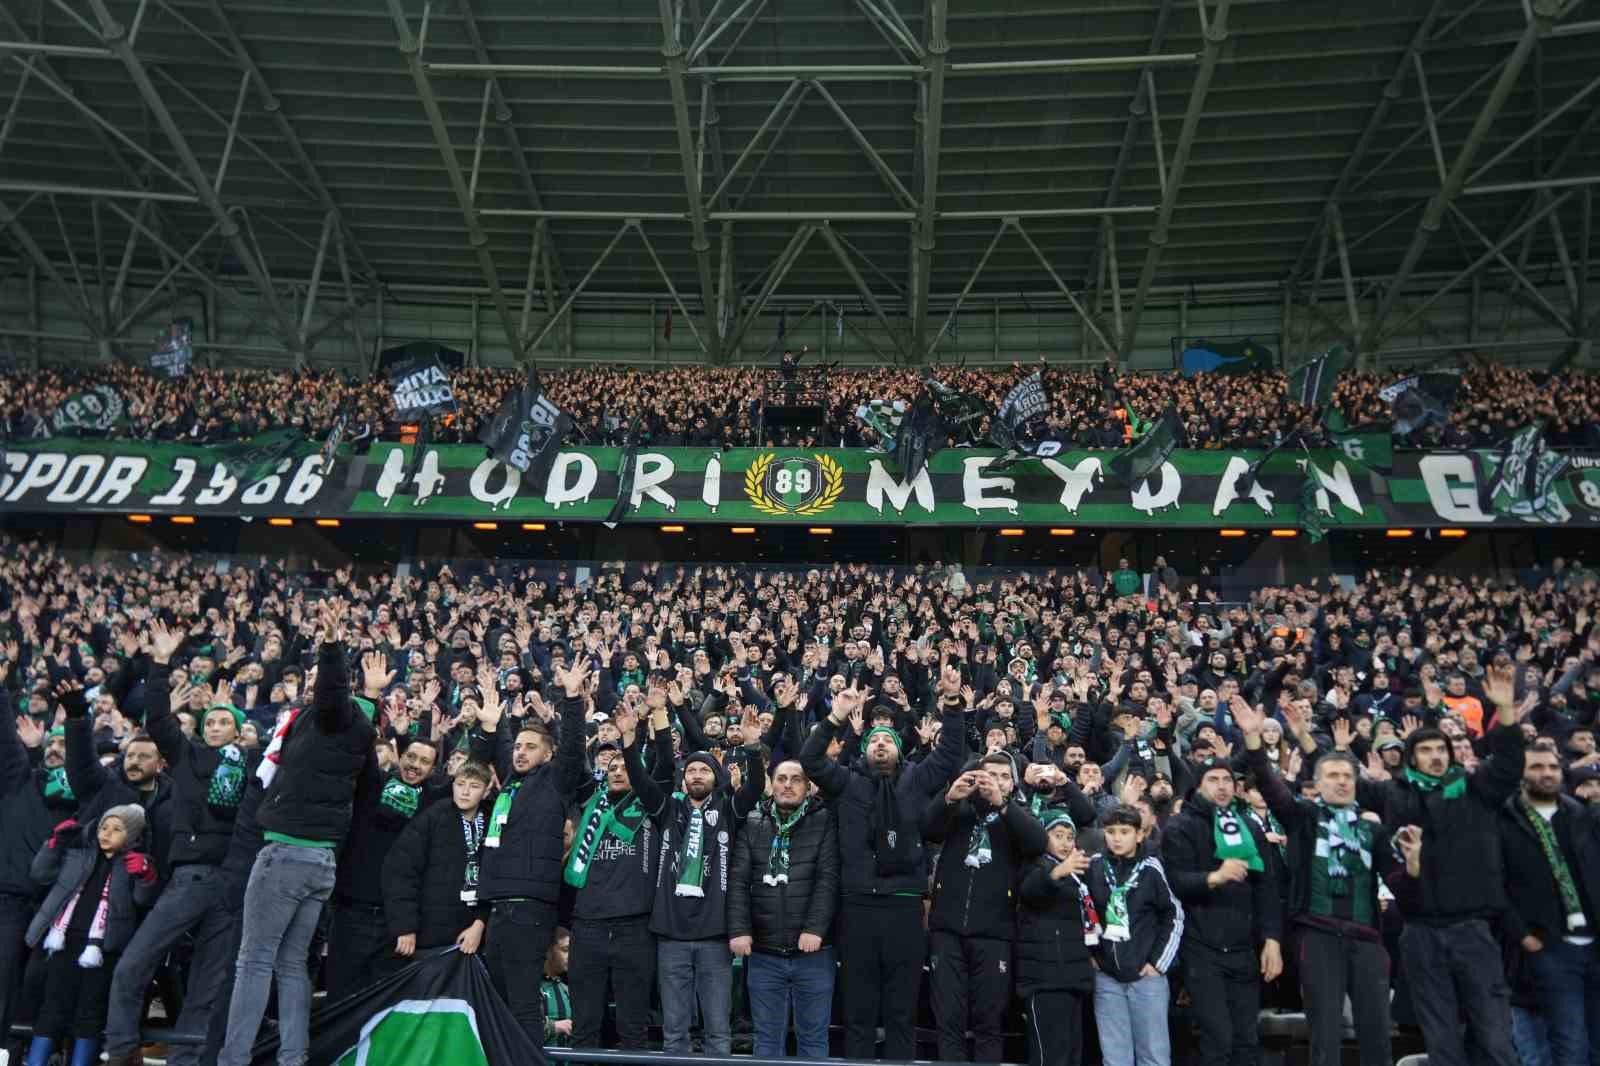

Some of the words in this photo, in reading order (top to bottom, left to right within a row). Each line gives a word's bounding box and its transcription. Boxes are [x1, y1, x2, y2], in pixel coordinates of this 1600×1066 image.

[775, 468, 812, 494] 89
[687, 818, 702, 858] ETMEZ
[719, 843, 729, 893] Avansas
